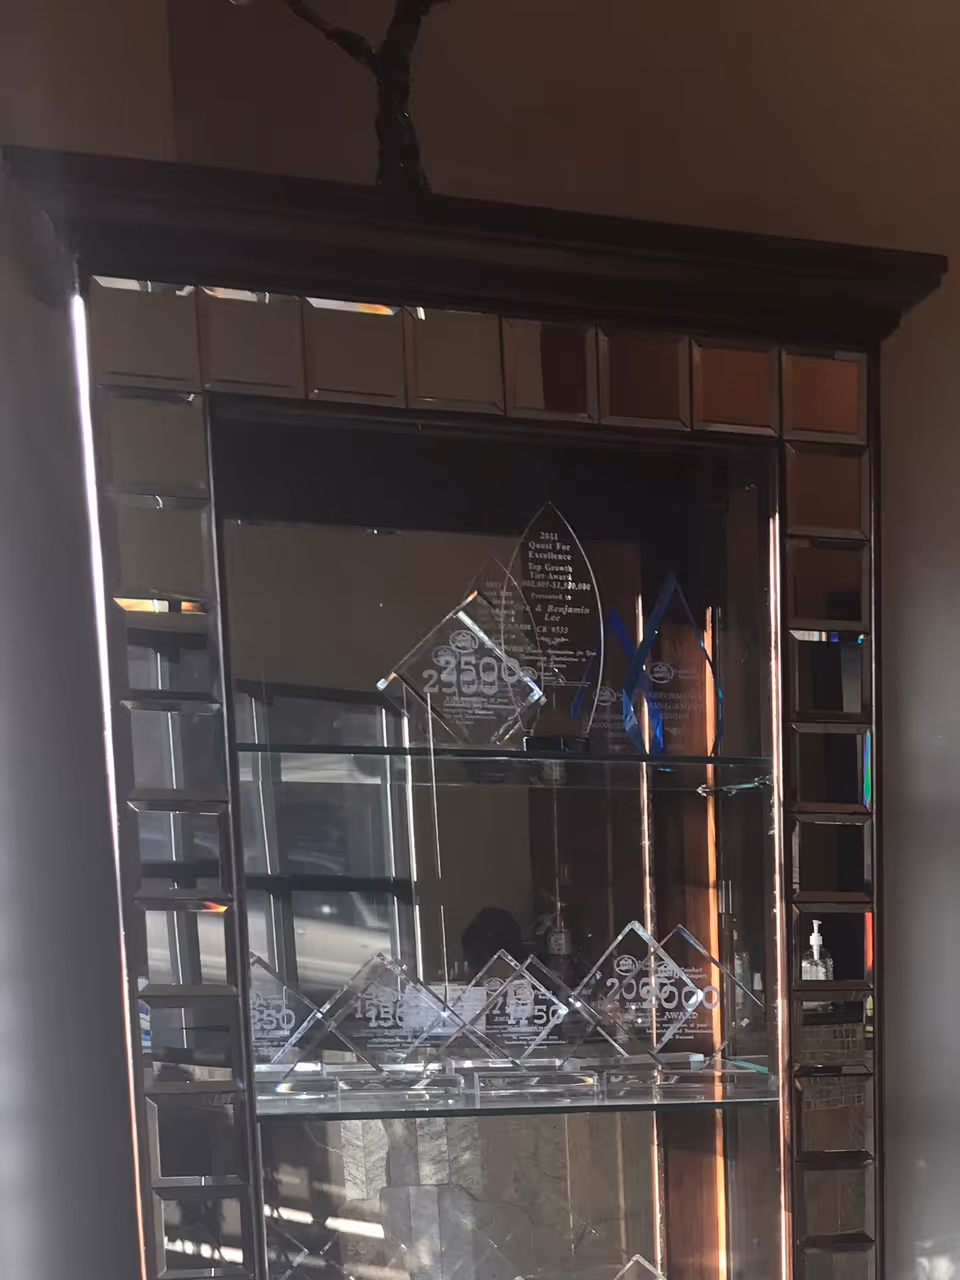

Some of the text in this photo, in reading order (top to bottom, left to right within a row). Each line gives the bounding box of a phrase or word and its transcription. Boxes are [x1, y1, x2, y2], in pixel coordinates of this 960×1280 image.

[540, 531, 558, 540] 2011
[528, 541, 571, 551] Quest For
[528, 550, 572, 560] Excellence
[528, 562, 572, 573] Top Growth
[530, 571, 572, 581] Tier Award
[535, 604, 541, 612] &
[547, 604, 590, 615] Benjamin
